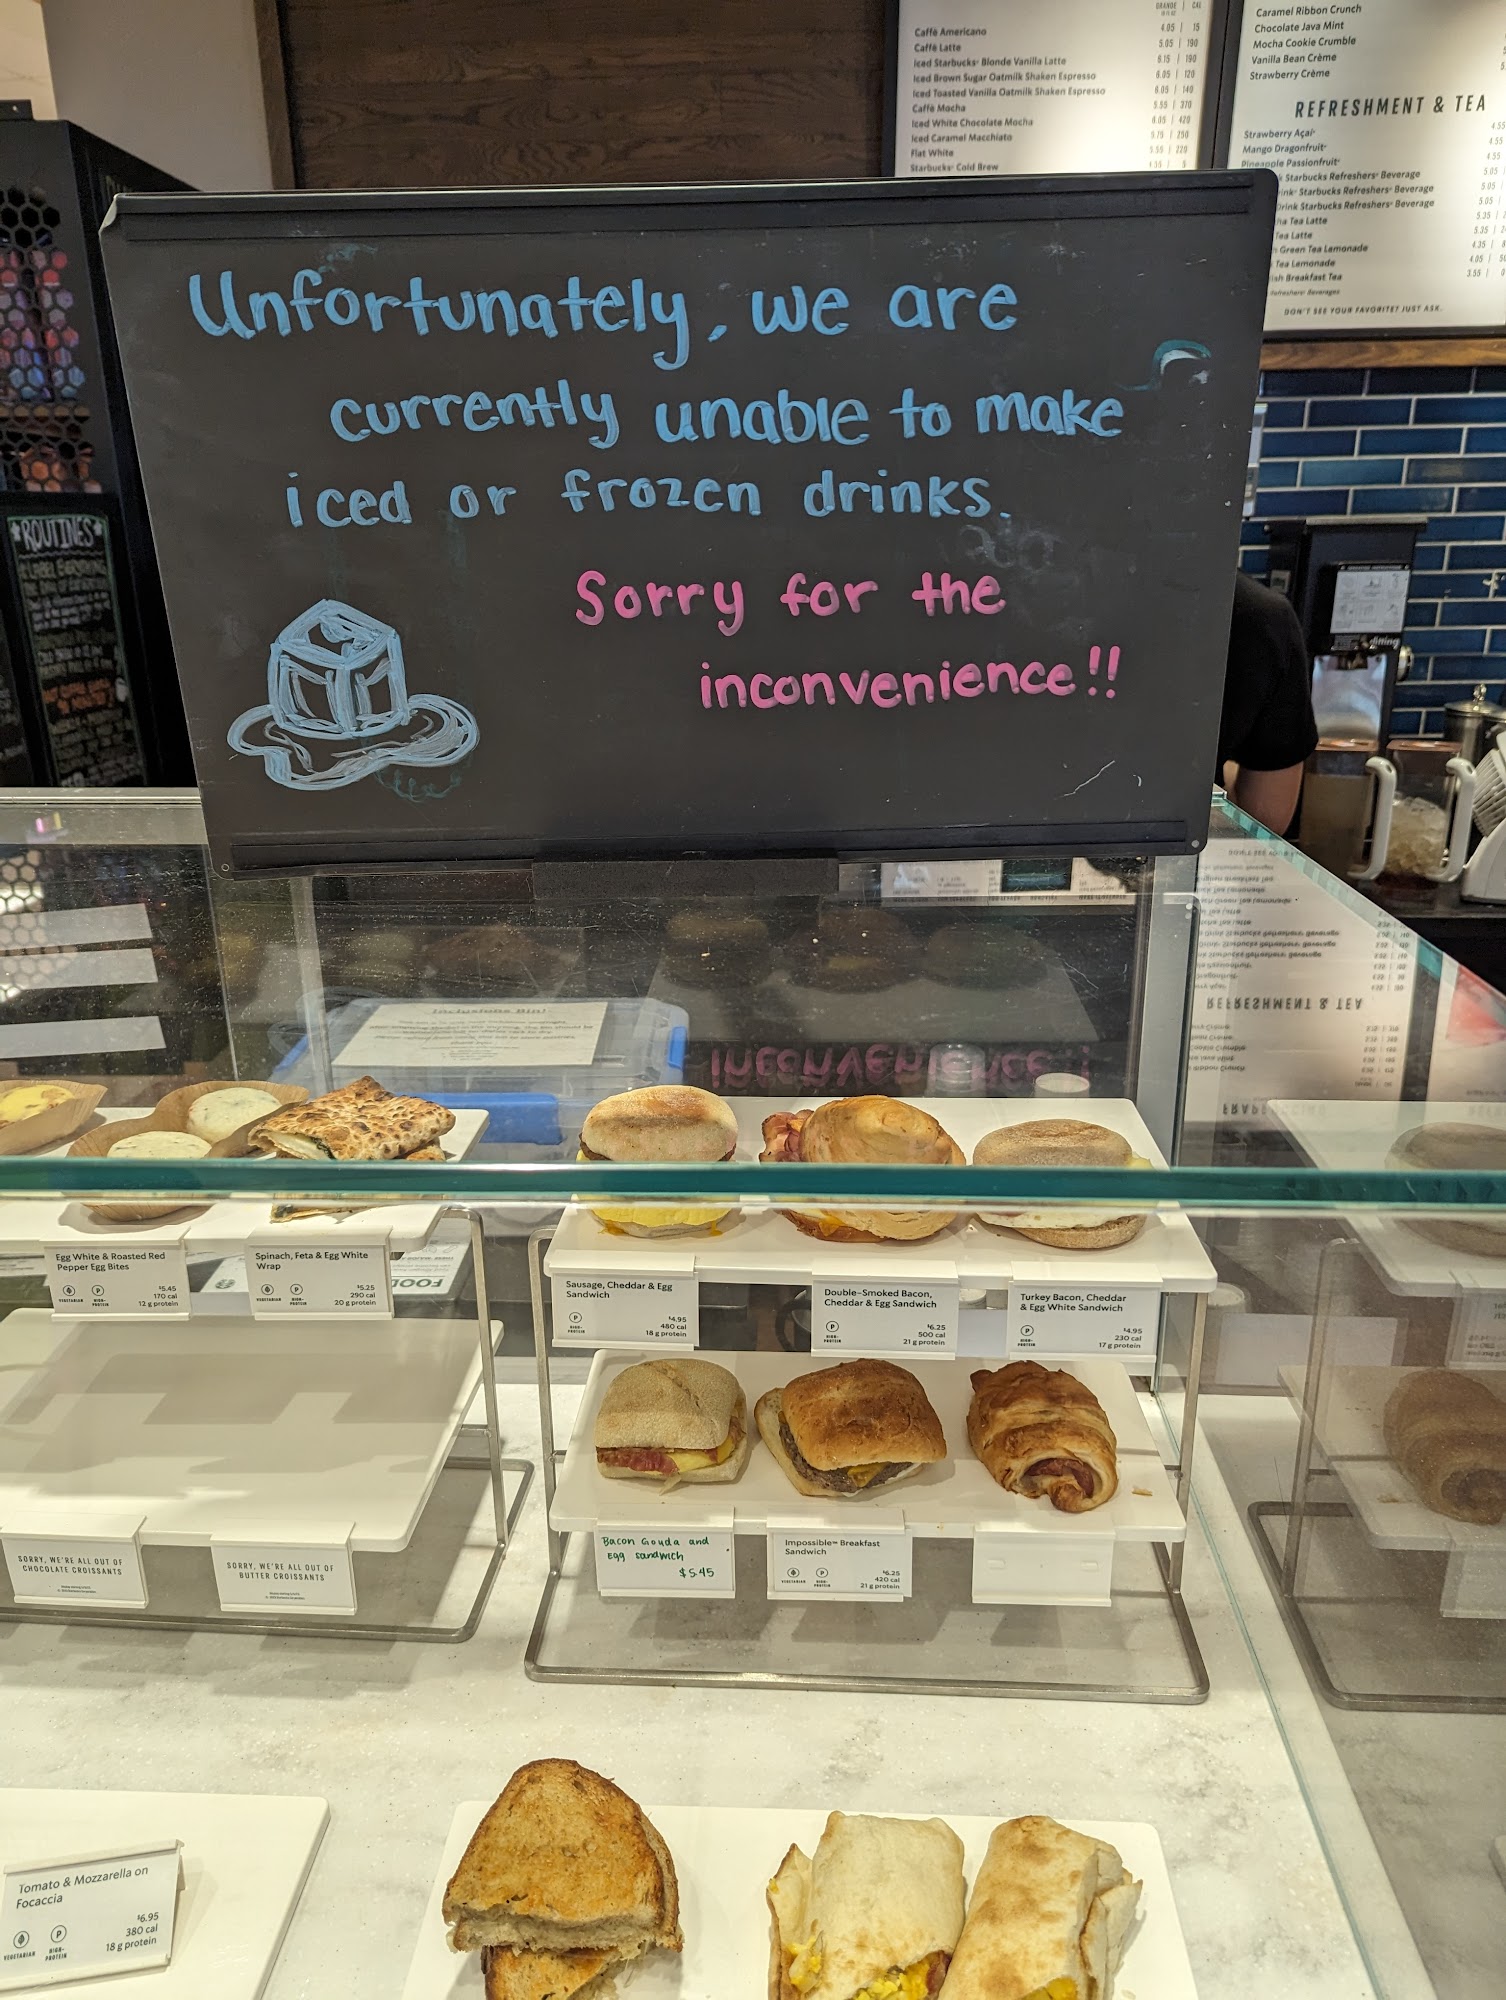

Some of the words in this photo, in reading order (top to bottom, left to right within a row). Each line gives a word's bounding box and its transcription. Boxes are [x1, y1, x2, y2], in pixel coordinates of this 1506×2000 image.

[1256, 6, 1294, 17] Caramel
[1296, 6, 1328, 16] Ribbon
[1330, 4, 1362, 15] Crunch
[914, 27, 937, 37] Caffè
[940, 27, 987, 37] Americano
[1161, 23, 1175, 32] 4.05
[1193, 23, 1200, 31] 15
[1254, 23, 1300, 34] Chocolate
[1301, 22, 1321, 32] Java
[1323, 21, 1344, 31] Mint
[914, 42, 937, 53] Caffè
[939, 42, 961, 52] Latte
[1253, 39, 1283, 49] Mocha
[1285, 38, 1316, 48] Cookie
[1318, 36, 1356, 47] Crumble
[1251, 55, 1281, 65] Vanilla
[1283, 54, 1305, 63] Bean
[1308, 52, 1337, 63] Crème
[913, 73, 931, 84] Iced
[933, 73, 961, 84] Brown
[963, 73, 987, 84] Sugar
[989, 72, 1023, 83] Oatmilk
[1025, 71, 1057, 82] Shaken
[1059, 71, 1096, 83] Espresso
[1250, 71, 1299, 81] Strawberry
[1300, 68, 1330, 79] Crème
[1295, 96, 1425, 118] REFRESHMENT
[1433, 96, 1444, 113] &
[1455, 95, 1486, 112] TEA
[750, 282, 851, 337] we
[888, 283, 1020, 332] are
[329, 378, 622, 450] currently
[654, 387, 871, 446] unable
[888, 386, 953, 439] to
[975, 387, 1126, 438] make
[286, 471, 413, 529] iced
[449, 484, 518, 520] or
[560, 467, 762, 516] frozen
[802, 468, 1012, 519] drinks.
[20, 518, 95, 552] ROUTINES
[575, 569, 746, 636] Sorry
[779, 571, 879, 617] for
[912, 570, 1007, 617] the
[700, 645, 1121, 709] inconvenience!!
[56, 1253, 71, 1262] Egg
[72, 1253, 100, 1261] White
[111, 1252, 147, 1260] Roasted
[149, 1252, 166, 1260] Red
[256, 1252, 293, 1260] Spinach,
[295, 1251, 313, 1259] Feta
[325, 1251, 339, 1261] Egg
[341, 1251, 368, 1259] White
[57, 1264, 88, 1272] Pepper
[91, 1264, 106, 1272] Egg
[108, 1263, 129, 1271] Bites
[256, 1262, 281, 1271] Wrap
[566, 1280, 605, 1290] Sausage,
[607, 1281, 645, 1290] Cheddar
[648, 1282, 654, 1290] &
[657, 1282, 673, 1292] Egg
[566, 1291, 610, 1299] Sandwich
[824, 1289, 899, 1297] Double-Smoked
[902, 1290, 932, 1299] Bacon,
[1020, 1293, 1050, 1302] Turkey
[1053, 1294, 1084, 1302] Bacon,
[1086, 1294, 1126, 1302] Cheddar
[153, 1300, 178, 1308] protein
[824, 1299, 863, 1307] Cheddar
[875, 1299, 891, 1308] Egg
[893, 1300, 937, 1308] Sandwich
[1029, 1304, 1045, 1312] Egg
[1048, 1304, 1076, 1312] White
[1078, 1304, 1123, 1312] Sandwich
[601, 1536, 635, 1546] Bacon
[641, 1537, 680, 1546] Gouda
[689, 1536, 709, 1545] and
[18, 1555, 46, 1564] SORRY,
[50, 1556, 74, 1564] WE'RE
[23, 1565, 69, 1573] CHOCOLATE
[72, 1566, 122, 1575] CROISSANTS
[227, 1562, 256, 1571] SORRY,
[259, 1562, 284, 1570] WE'RE
[239, 1572, 270, 1580] BUTTER
[274, 1573, 325, 1581] CROISSANTS
[18, 1881, 60, 1894] Tomato
[63, 1877, 71, 1888] &
[74, 1868, 132, 1886] Mozzarella
[135, 1867, 149, 1875] on
[16, 1893, 63, 1909] Focaccia
[137, 1912, 159, 1922] $6.95
[126, 1926, 143, 1936] 380
[145, 1924, 158, 1933] cal
[106, 1942, 115, 1951] 18
[117, 1943, 122, 1952] g
[124, 1937, 157, 1950] protein
[3, 1951, 36, 1961] VEGETARIAN
[45, 1953, 68, 1961] PROTEIN
